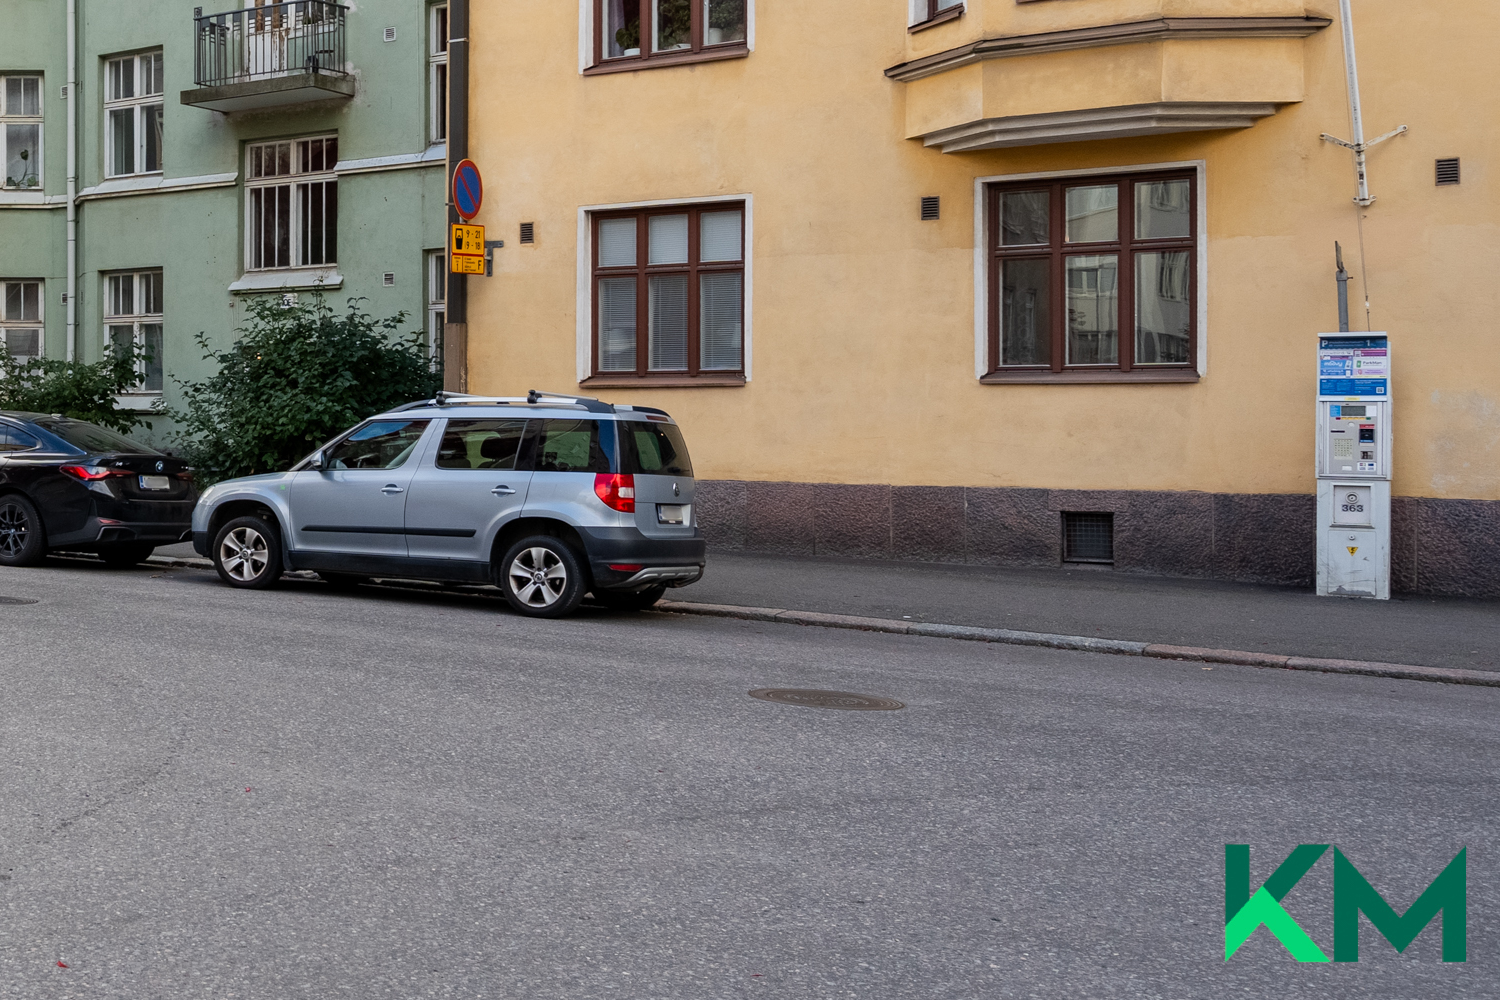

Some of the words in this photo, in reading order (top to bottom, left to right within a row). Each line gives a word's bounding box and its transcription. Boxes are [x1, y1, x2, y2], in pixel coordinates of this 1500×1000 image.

[466, 229, 470, 238] 9
[475, 230, 481, 239] 21
[477, 259, 482, 270] F
[1342, 504, 1364, 512] 363
